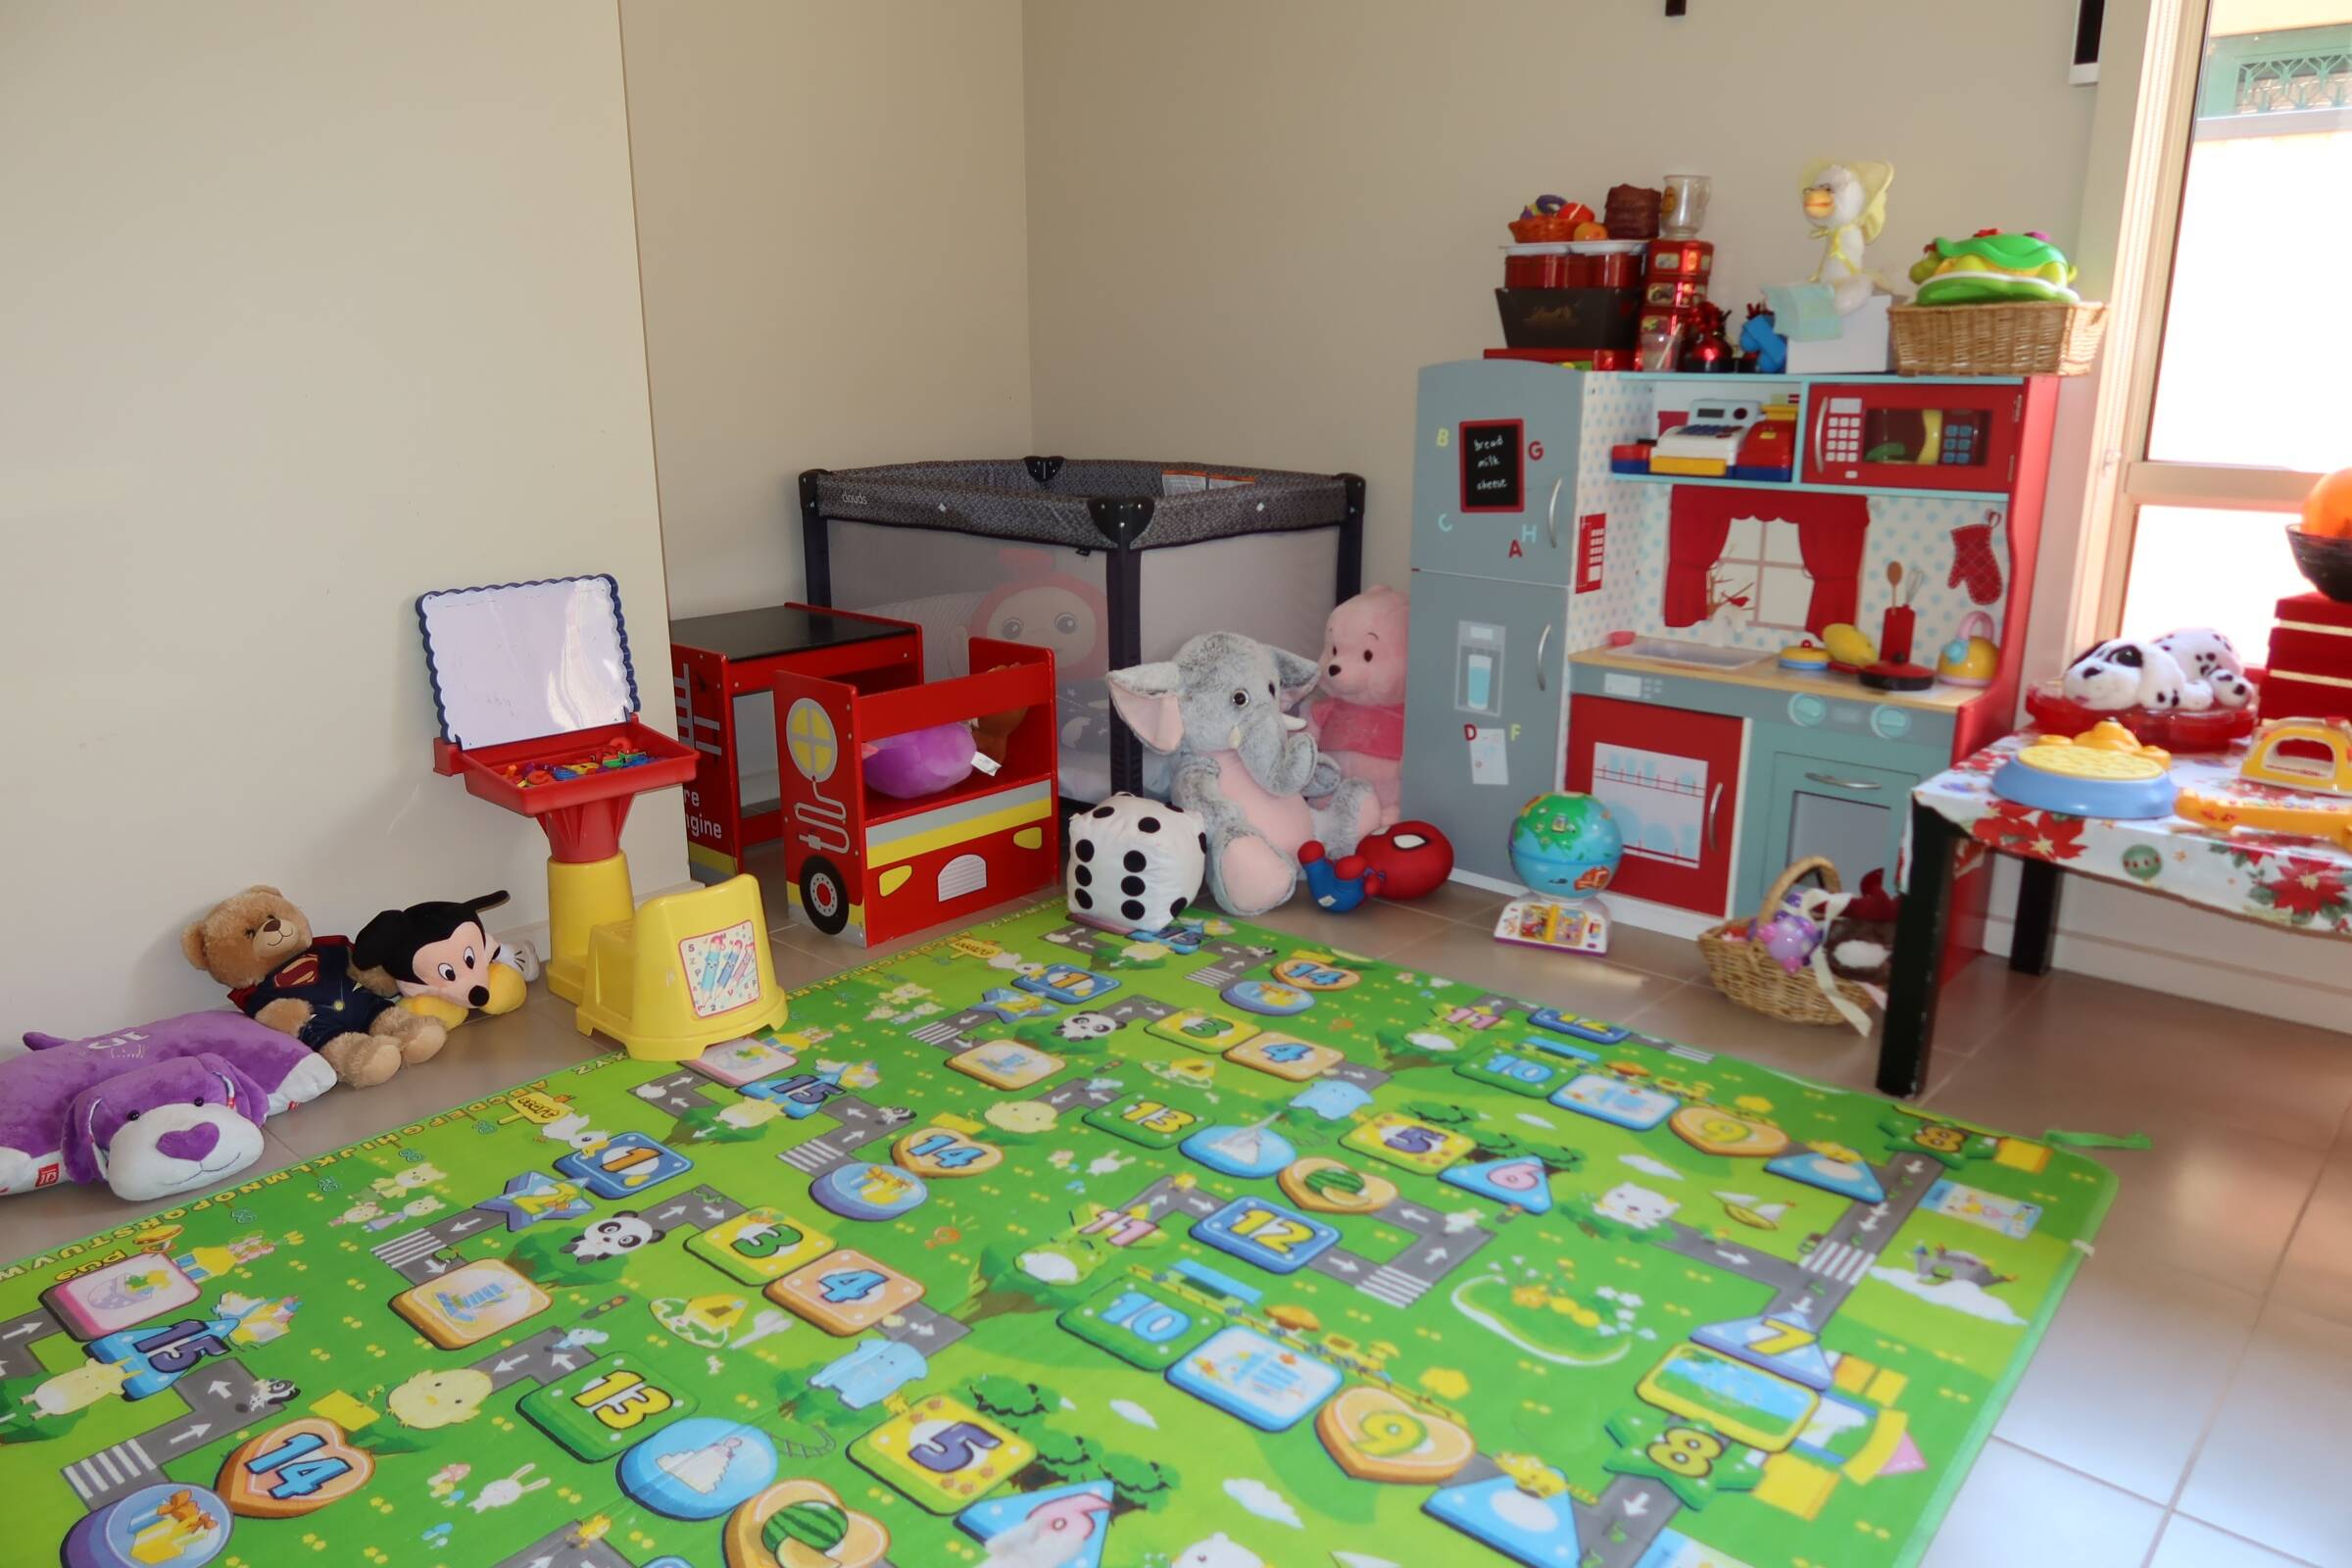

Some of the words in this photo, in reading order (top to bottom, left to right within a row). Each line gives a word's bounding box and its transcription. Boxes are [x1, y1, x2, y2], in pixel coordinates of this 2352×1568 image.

[1437, 427, 1449, 447] B
[1474, 435, 1504, 451] bread
[1528, 440, 1544, 461] G
[1478, 455, 1500, 467] milk
[1477, 478, 1507, 490] cheese
[1438, 513, 1453, 532] C
[1521, 523, 1537, 544] H
[1508, 539, 1522, 558] A
[1463, 723, 1478, 741] D
[1510, 723, 1522, 742] F
[1287, 962, 1347, 986] 14
[1259, 1042, 1314, 1062] 4
[1485, 1053, 1553, 1083] 10
[769, 1074, 847, 1104] 15
[1121, 1101, 1197, 1133] 13
[907, 1134, 987, 1168] 14
[1383, 1126, 1449, 1153] 5
[1913, 1126, 1967, 1152] 8
[599, 1147, 663, 1173] 1
[513, 1182, 581, 1214] 2
[730, 1224, 804, 1257] 3
[1077, 1209, 1160, 1247] 11
[1228, 1208, 1317, 1254] 12
[815, 1269, 890, 1304] 4
[1099, 1291, 1192, 1344] 10
[132, 1318, 232, 1374] 15
[569, 1370, 674, 1431] 13
[907, 1421, 1004, 1473] 5
[1646, 1427, 1724, 1479] 8
[244, 1432, 354, 1500] 14
